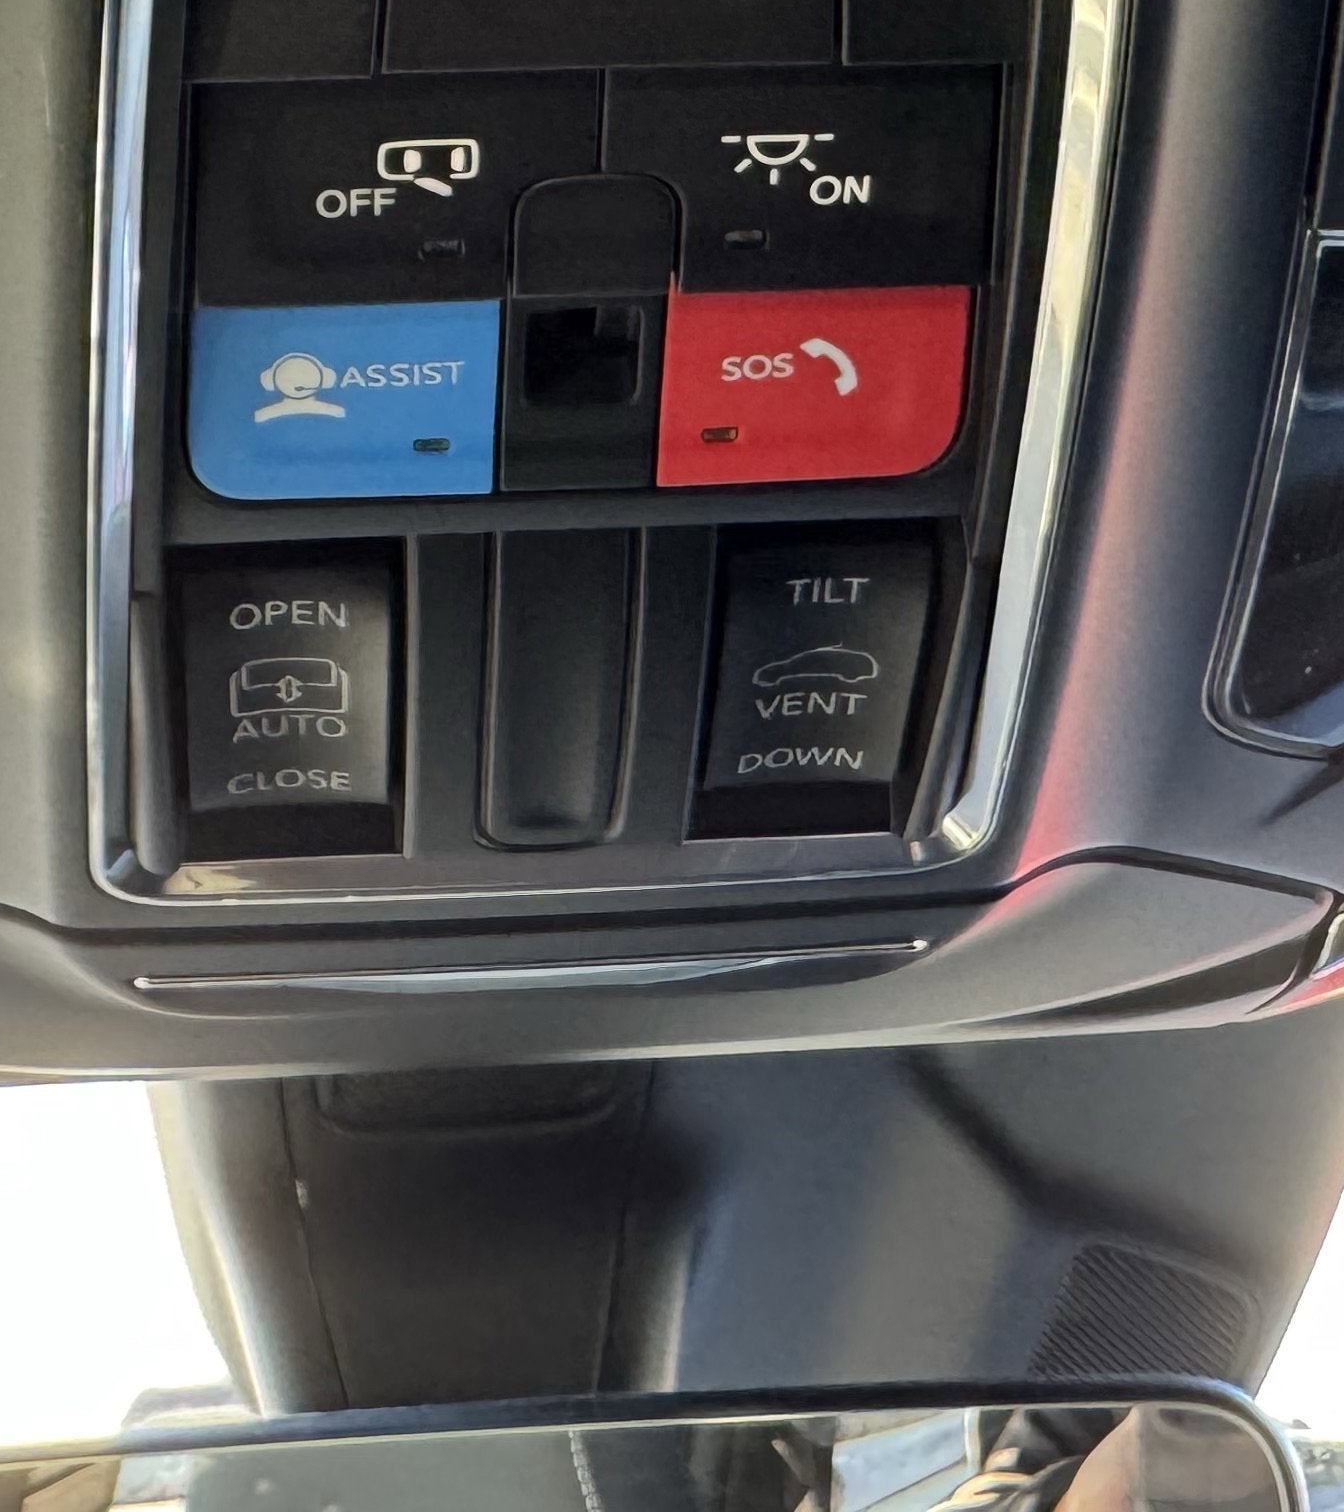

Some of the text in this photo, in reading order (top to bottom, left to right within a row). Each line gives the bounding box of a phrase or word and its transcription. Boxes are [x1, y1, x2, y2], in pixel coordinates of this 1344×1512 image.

[315, 187, 397, 219] OFF
[808, 174, 872, 206] ON
[339, 359, 466, 389] ASSIST
[721, 353, 796, 382] SOS
[786, 576, 871, 605] TILT
[229, 600, 349, 631] OPEN
[753, 691, 869, 721] VENT
[231, 714, 349, 743] AUTO
[736, 747, 864, 774] DOWN
[227, 769, 352, 795] CLOSE
